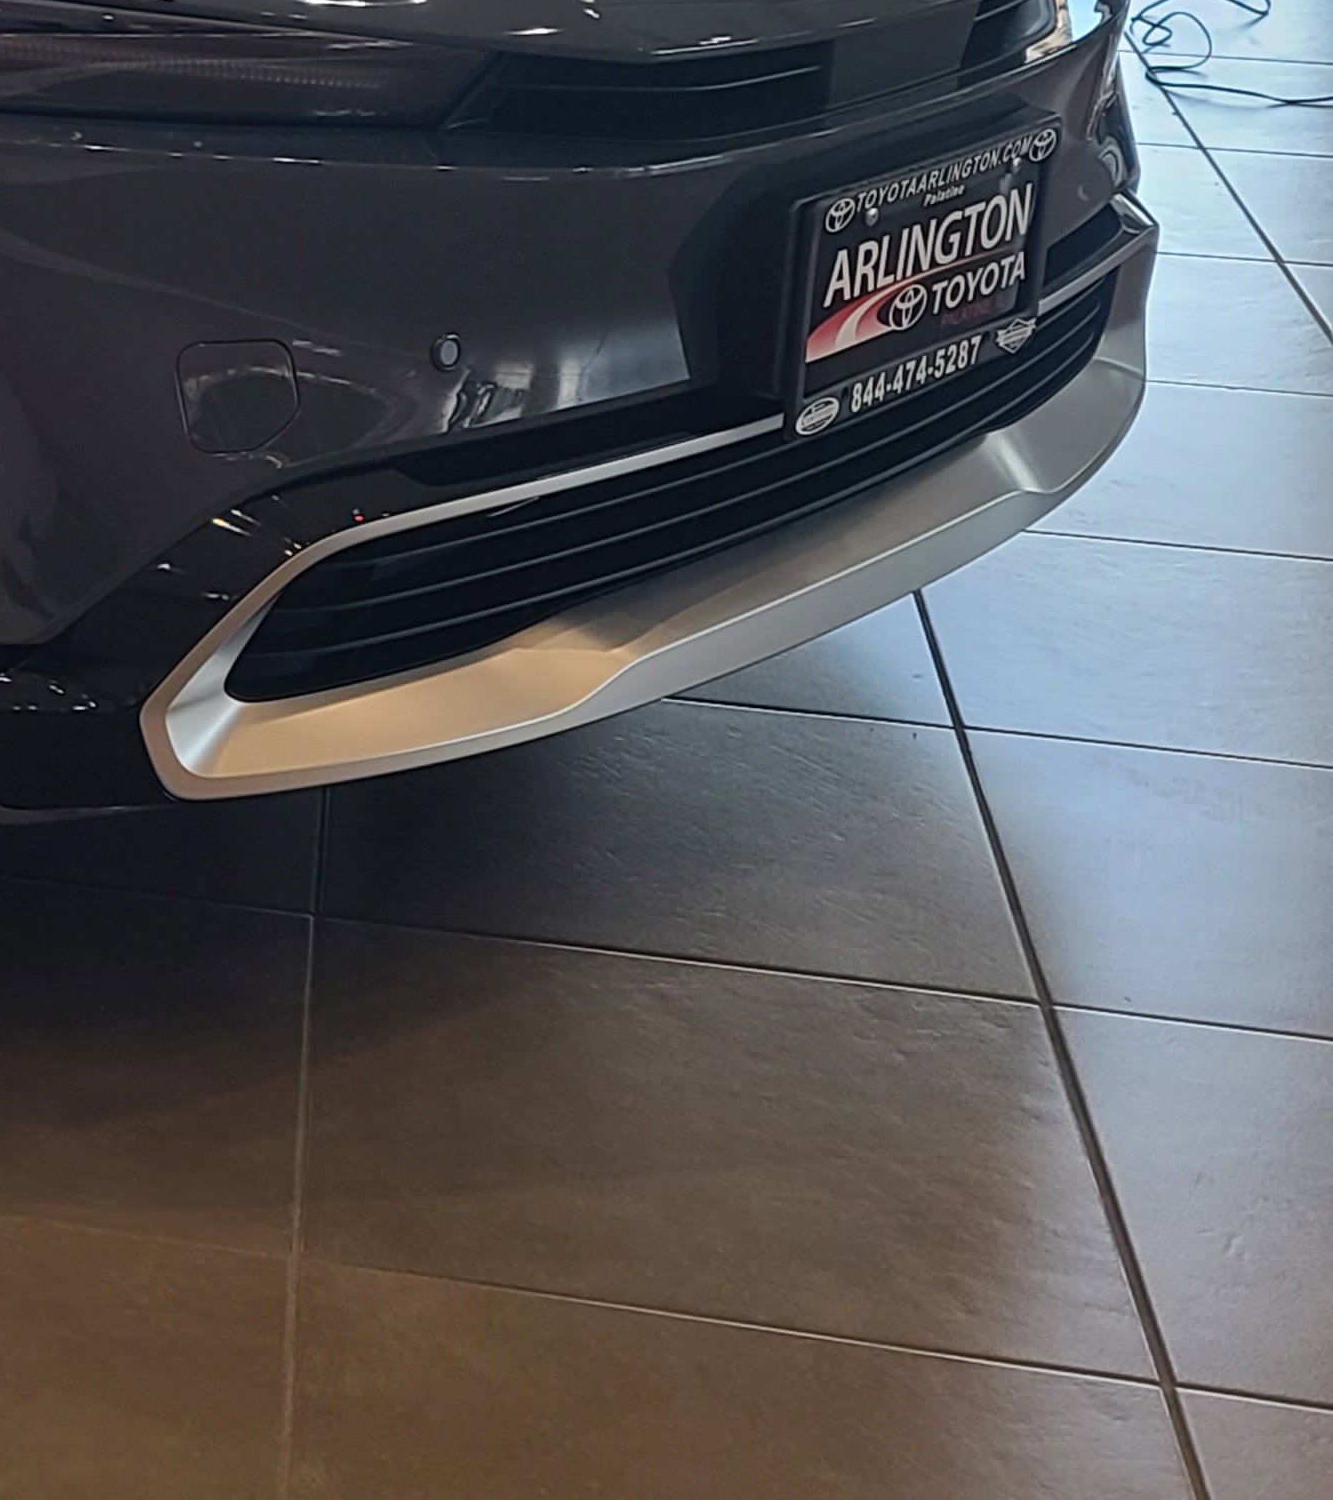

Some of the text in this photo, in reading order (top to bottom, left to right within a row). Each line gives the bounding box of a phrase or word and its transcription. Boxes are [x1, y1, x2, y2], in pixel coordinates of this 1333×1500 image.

[856, 136, 1032, 213] TOYOTAARLINGTON.COM
[822, 182, 1035, 309] ARLINGTON
[931, 250, 1028, 316] TOYOTA
[849, 335, 983, 414] 844-474-5287
